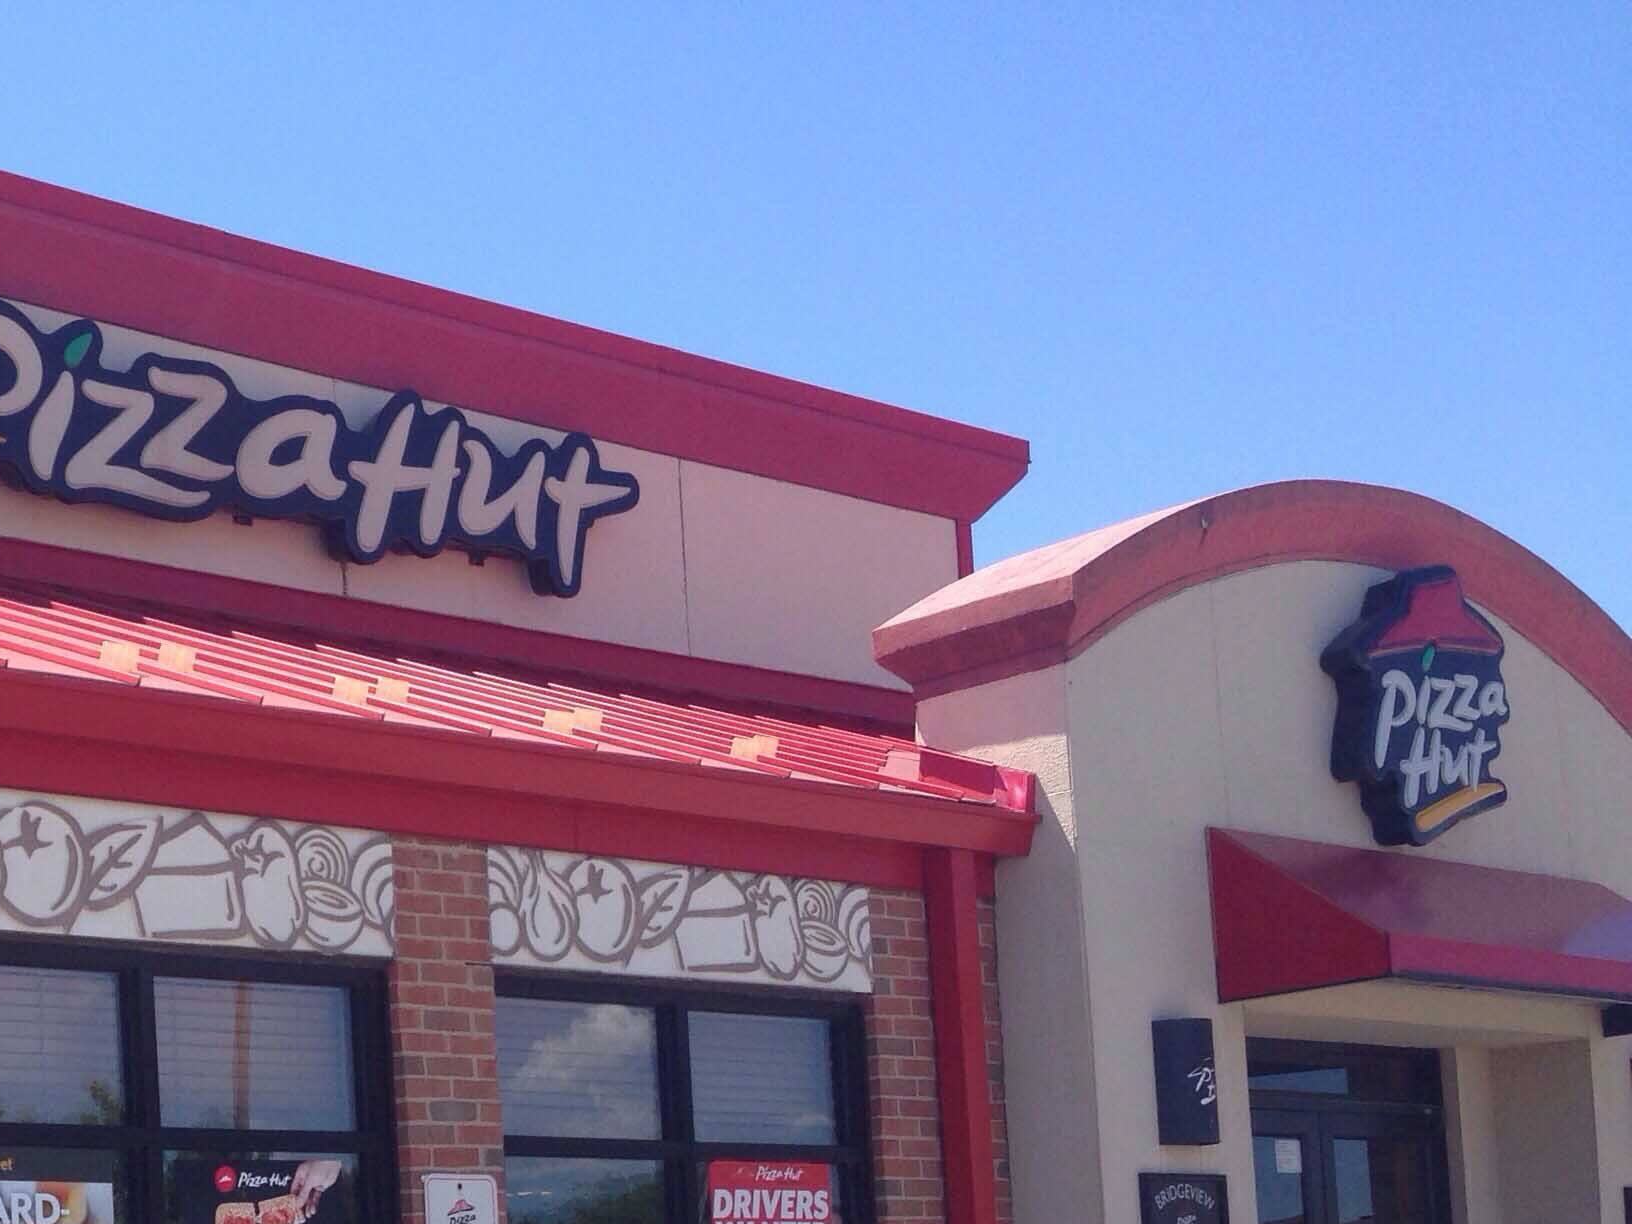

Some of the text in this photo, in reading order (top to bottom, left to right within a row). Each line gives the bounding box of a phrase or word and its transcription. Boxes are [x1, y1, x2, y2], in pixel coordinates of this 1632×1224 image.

[348, 402, 632, 587] Hut
[1374, 644, 1508, 769] Pizza
[1400, 728, 1497, 808] Hut
[238, 1171, 292, 1188] Pizza Hut
[754, 1165, 805, 1181] Pizza Hut
[712, 1188, 829, 1220] DRIVERS
[1153, 1183, 1216, 1210] BRIDGEVIEW
